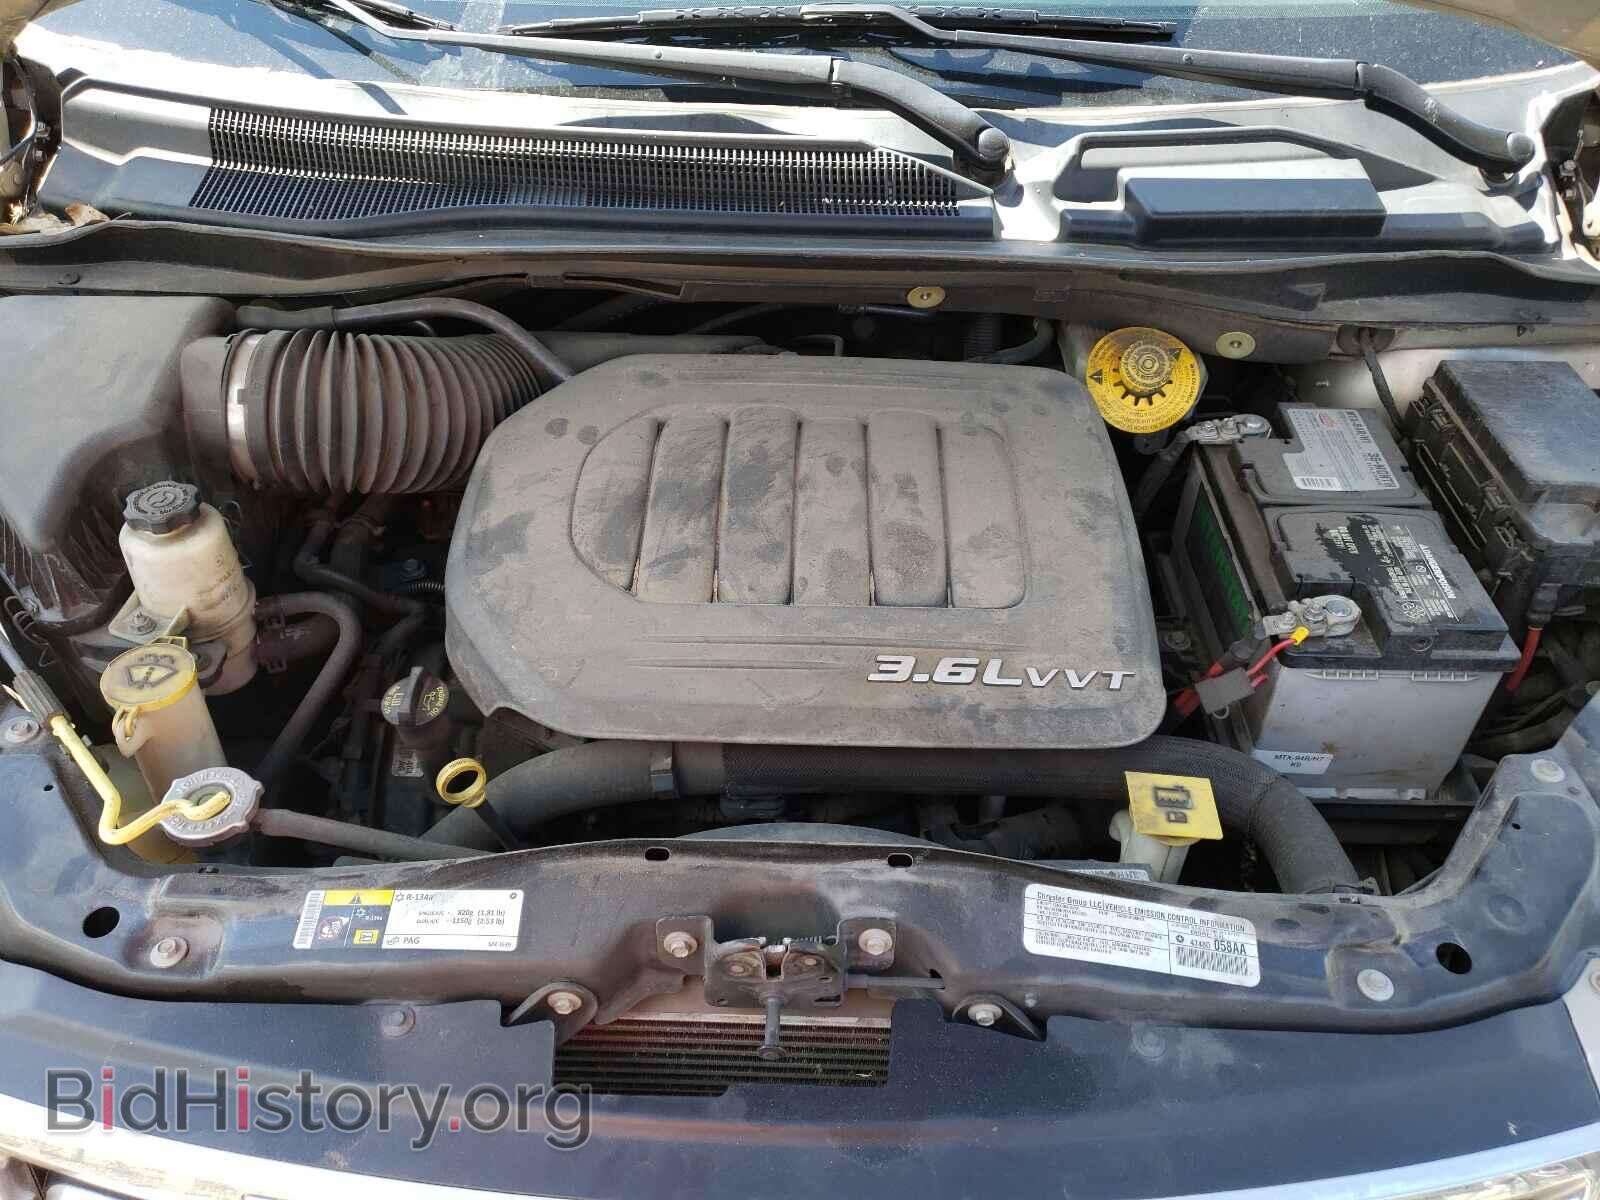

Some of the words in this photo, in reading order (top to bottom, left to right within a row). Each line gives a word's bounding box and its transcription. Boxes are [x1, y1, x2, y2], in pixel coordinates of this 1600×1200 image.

[1037, 891, 1065, 903] Chrysler
[1067, 896, 1087, 907] Group
[1104, 902, 1132, 914] VEHICLE
[1134, 905, 1166, 920] EMISSION
[1167, 912, 1198, 925] CONTROL
[1199, 918, 1246, 932] INFORMATION
[402, 936, 421, 945] PAG
[1214, 939, 1247, 955] 058AA
